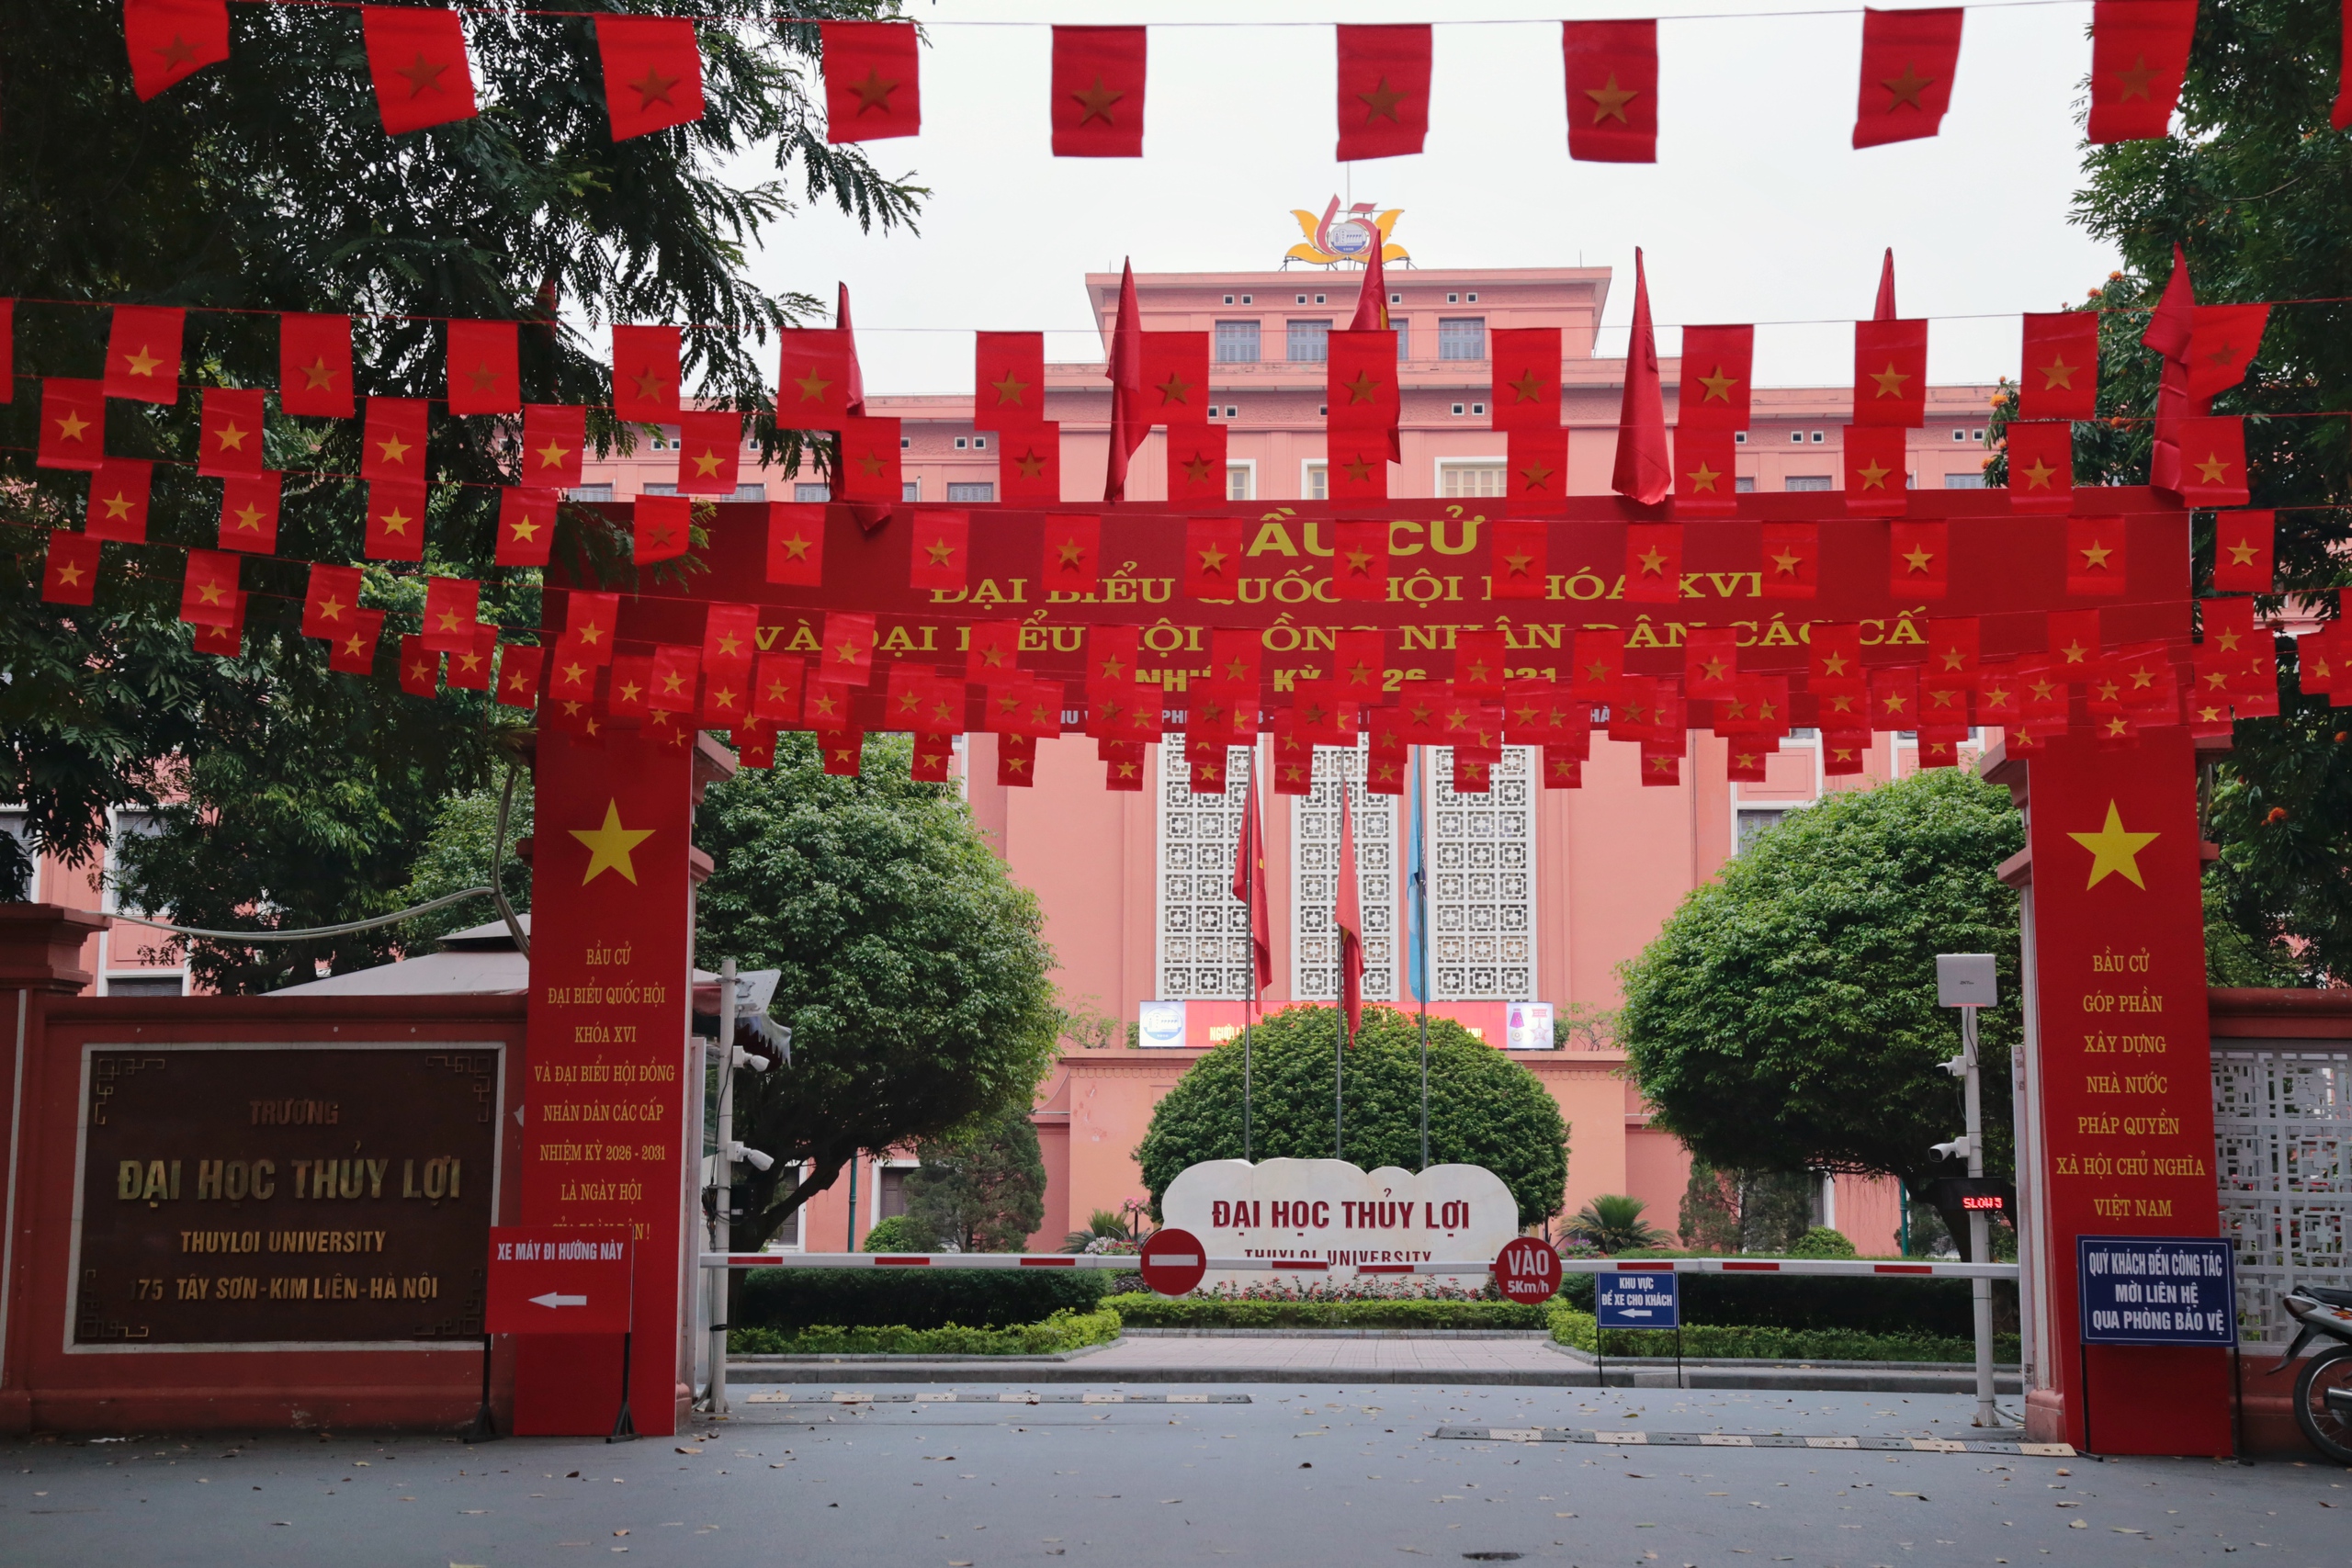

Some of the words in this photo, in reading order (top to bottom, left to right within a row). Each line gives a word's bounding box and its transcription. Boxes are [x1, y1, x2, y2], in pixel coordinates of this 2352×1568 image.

[1240, 508, 1334, 557] ẦU
[1388, 505, 1486, 556] CỬ
[754, 618, 823, 651] VÀ
[586, 940, 611, 964] BẦU
[615, 941, 631, 964] CỬ
[2093, 945, 2124, 972] BẦU
[2129, 947, 2150, 972] CỬ
[548, 987, 570, 1009] ĐẠI
[573, 976, 603, 1004] BIỂU
[606, 979, 639, 1005] QUỐC
[643, 981, 665, 1008] HỘI
[2083, 989, 2114, 1012] GÓP
[2119, 986, 2163, 1012] PHẦN
[574, 1021, 610, 1043] KHÓA
[614, 1026, 636, 1043] XVI
[2084, 1030, 2118, 1052] XÂY
[2122, 1033, 2166, 1057] DỰNG
[534, 1061, 551, 1082] VÀ
[555, 1066, 577, 1086] ĐẠI
[581, 1055, 610, 1082] BIỂU
[613, 1060, 636, 1086] HỘI
[639, 1056, 675, 1081] ĐỒNG
[2086, 1071, 2121, 1093] NHÀ
[2125, 1071, 2167, 1093] NƯỚC
[543, 1100, 580, 1122] NHÂN
[582, 1100, 610, 1122] DÂN
[613, 1099, 637, 1121] CÁC
[639, 1096, 663, 1121] CẤP
[2078, 1111, 2120, 1134] PHÁP
[2124, 1108, 2179, 1135] QUYỀN
[539, 1139, 582, 1165] NHIỆM
[584, 1139, 603, 1160] KỲ
[605, 1145, 631, 1160] 2026
[641, 1145, 665, 1160] 2031
[2056, 1153, 2079, 1174] XÃ
[2083, 1152, 2112, 1179] HỘI
[2117, 1150, 2148, 1176] CHỦ
[2154, 1155, 2206, 1176] NGHĨA
[118, 1160, 182, 1208] ĐẠI
[198, 1159, 275, 1209] HỌC
[402, 1155, 460, 1208] LỢI
[560, 1179, 577, 1201] LÀ
[581, 1179, 616, 1201] NGÀY
[619, 1179, 642, 1204] HỘI
[1212, 1201, 1261, 1236] ĐẠI
[1272, 1201, 1329, 1236] HỌC
[1341, 1188, 1415, 1229] THỦY
[1425, 1200, 1470, 1237] LỢI
[2094, 1193, 2131, 1221] VIỆT
[2135, 1200, 2173, 1217] NAM
[181, 1231, 260, 1253] THUYLOI
[268, 1230, 386, 1253] UNIVERSITY
[497, 1243, 512, 1260] XE
[515, 1239, 540, 1260] MÁY
[543, 1243, 555, 1260] ĐI
[559, 1239, 597, 1260] HƯỚNG
[600, 1239, 624, 1259] NÀY
[1329, 1250, 1431, 1266] UNIVERSITY
[1508, 1245, 1549, 1276] VÀO
[2088, 1247, 2109, 1277] QUÝ
[2111, 1248, 2145, 1275] KHÁCH
[2148, 1247, 2170, 1276] ĐẾN
[2172, 1249, 2200, 1277] CÔNG
[2202, 1250, 2222, 1277] TÁC
[176, 1273, 209, 1300] TÂY
[402, 1271, 437, 1303] NỘI
[1508, 1280, 1549, 1294] 5Km/h
[1619, 1277, 1636, 1289] KHU
[1637, 1276, 1654, 1292] VỰC
[2115, 1280, 2143, 1303] MỜI
[2145, 1281, 2177, 1303] LIÊN
[2181, 1282, 2199, 1308] HỆ
[1601, 1290, 1612, 1306] ĐỂ
[1614, 1294, 1625, 1306] XE
[1627, 1294, 1643, 1306] CHO
[1645, 1292, 1672, 1306] KHÁCH
[2092, 1311, 2120, 1330] QUA
[2123, 1307, 2171, 1330] PHÒNG
[2175, 1306, 2203, 1331] BẢO
[2207, 1309, 2224, 1336] VỆ
